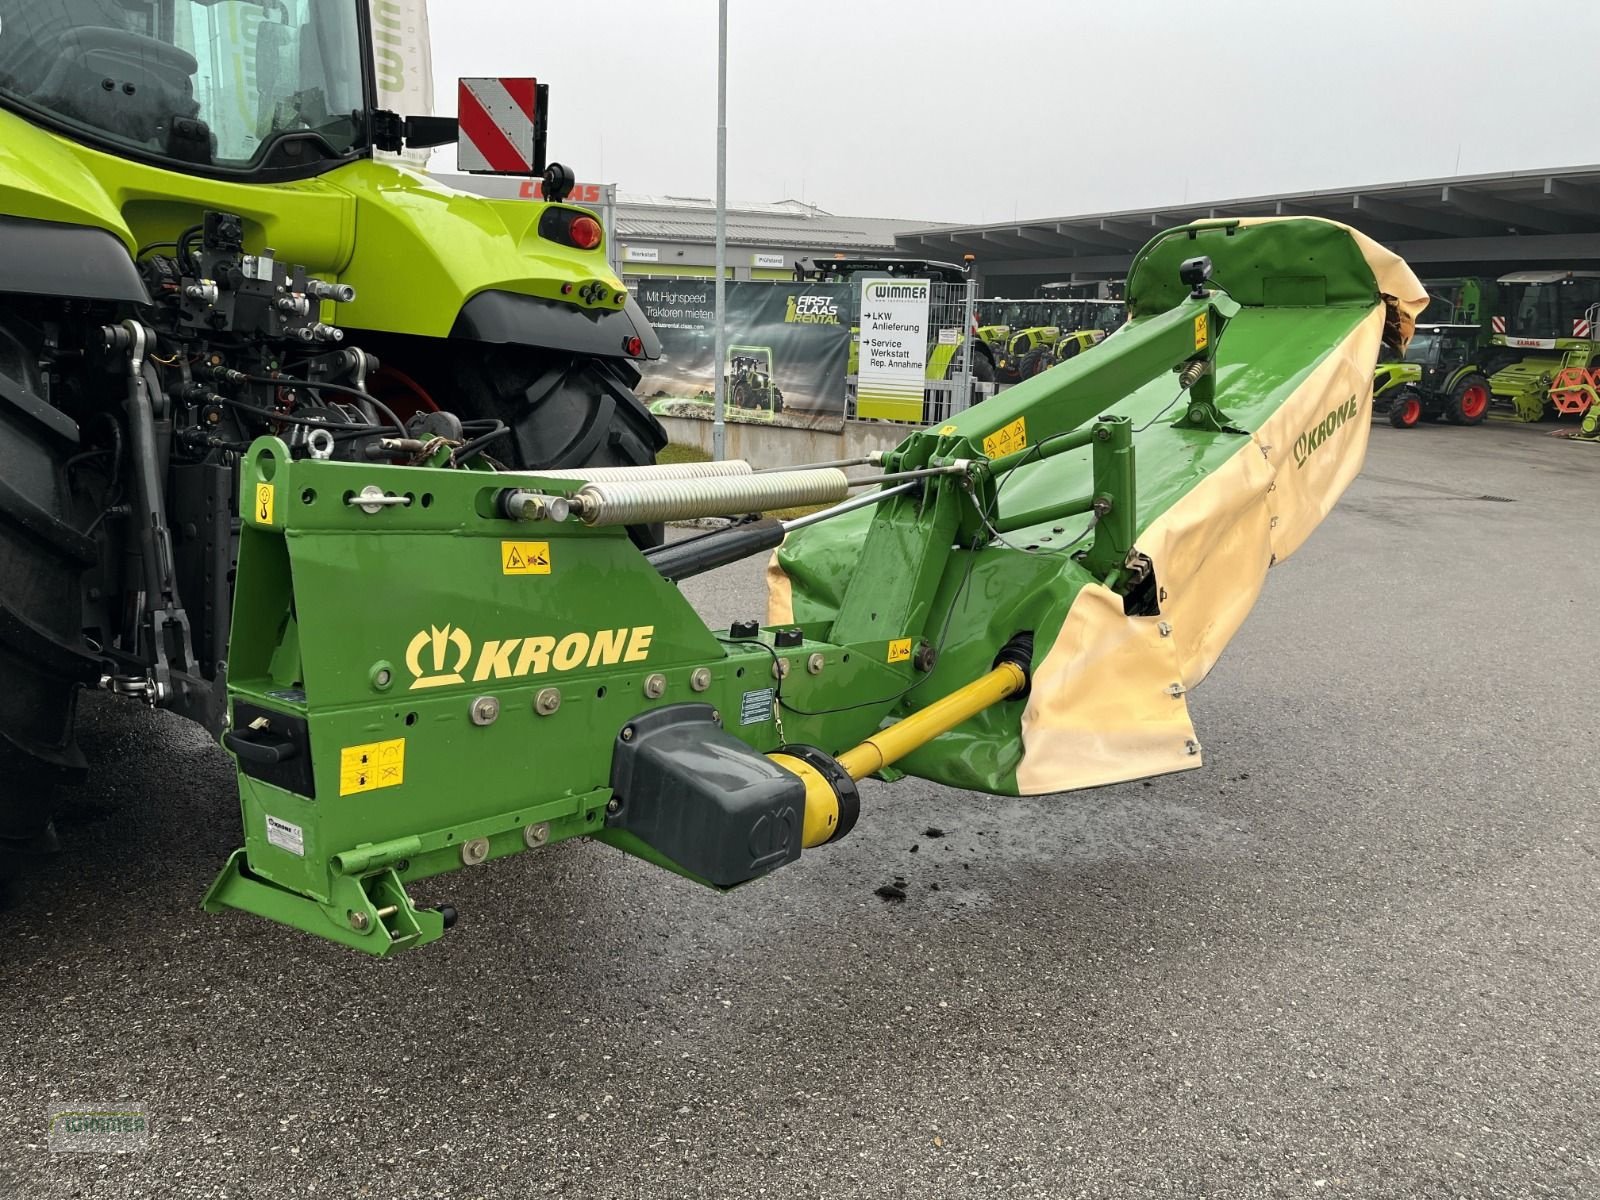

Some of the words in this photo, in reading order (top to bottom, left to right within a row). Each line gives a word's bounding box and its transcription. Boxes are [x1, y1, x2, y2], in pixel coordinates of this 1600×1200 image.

[631, 250, 657, 258] Werkstatt
[875, 286, 927, 299] WIMMER
[646, 291, 659, 302] Mit
[661, 292, 706, 305] Highspeed
[798, 296, 834, 306] FIRST
[646, 306, 683, 318] Traktoren
[685, 308, 714, 320] mieten
[796, 305, 838, 315] CLAAS
[793, 314, 840, 325] RENTAL
[872, 312, 892, 321] LKW
[872, 322, 920, 333] Anlieferung
[871, 339, 902, 348] Service
[871, 349, 909, 358] Werkstatt
[870, 359, 887, 368] Rep.
[888, 360, 923, 369] Annahme
[1308, 394, 1357, 456] KRONE
[472, 625, 654, 682] KRONE
